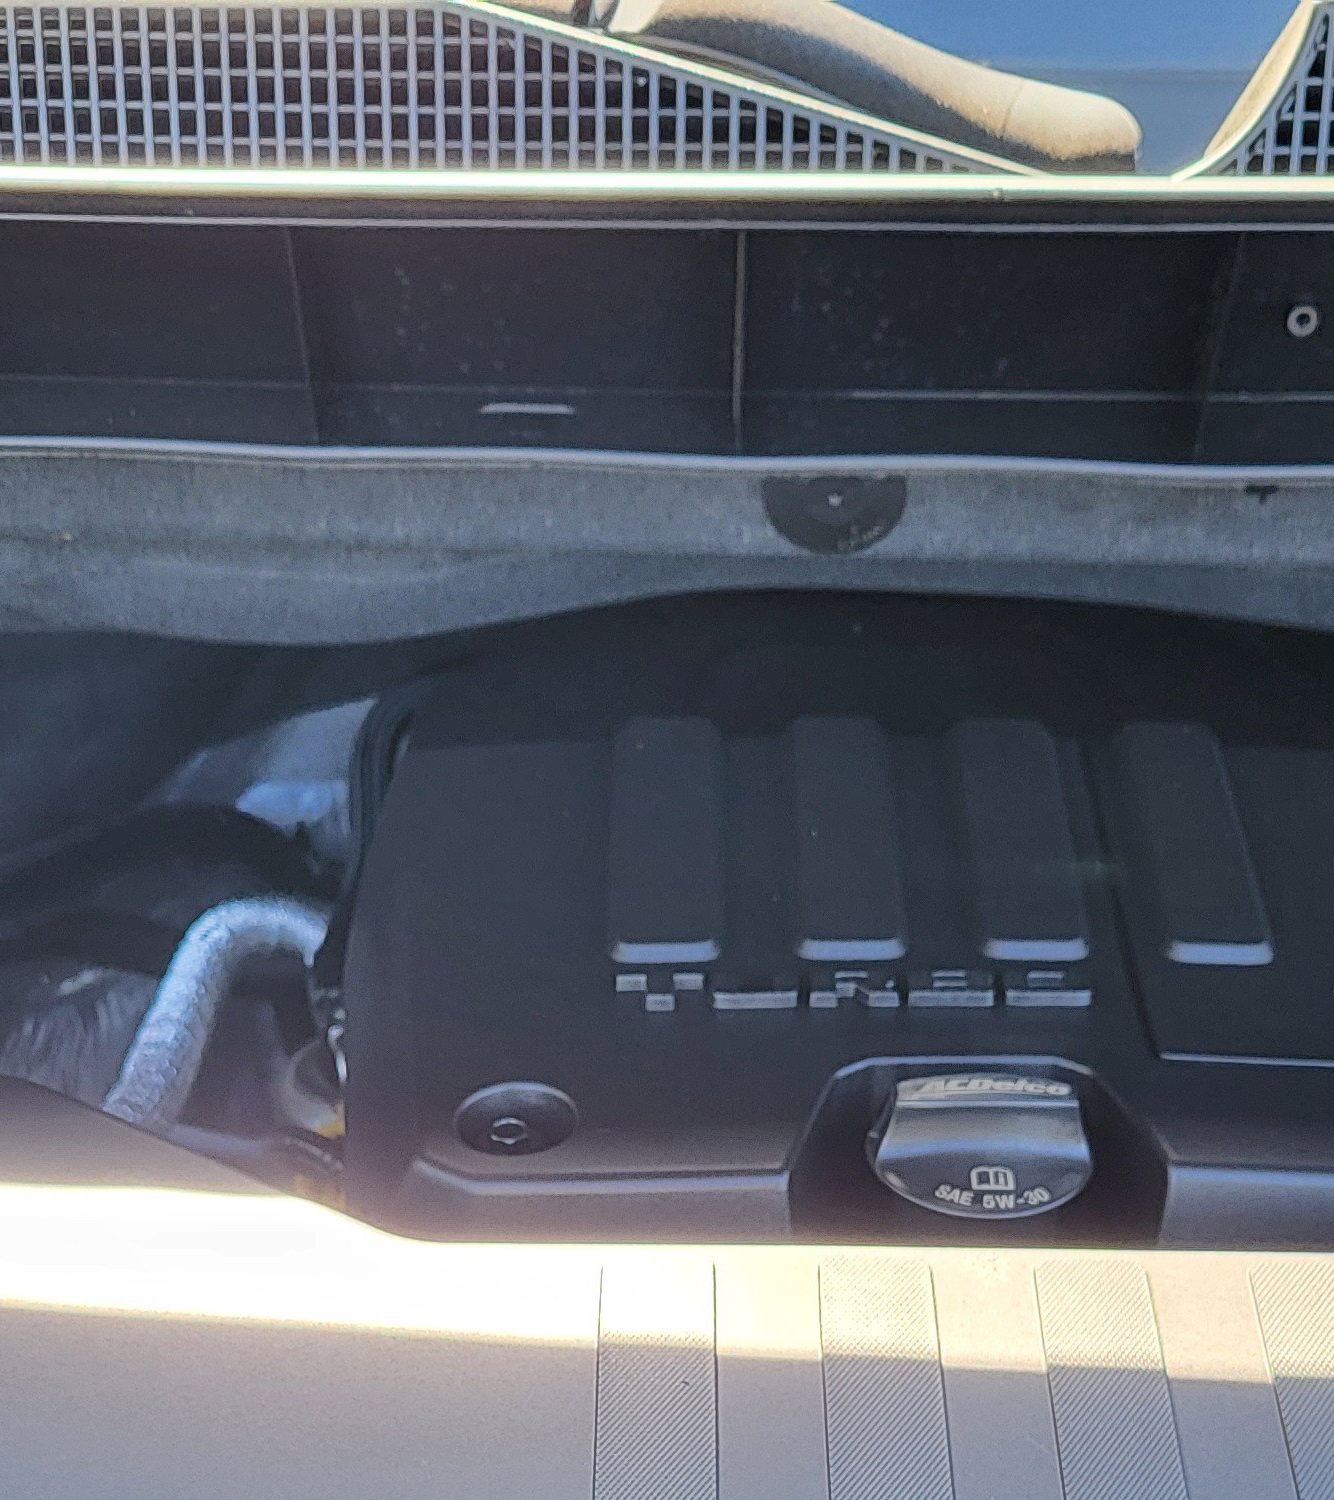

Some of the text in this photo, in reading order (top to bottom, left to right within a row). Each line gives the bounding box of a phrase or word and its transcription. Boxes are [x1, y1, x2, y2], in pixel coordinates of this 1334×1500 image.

[909, 1077, 1071, 1098] ACDelco
[934, 1183, 1051, 1210] SAE 5W-30
